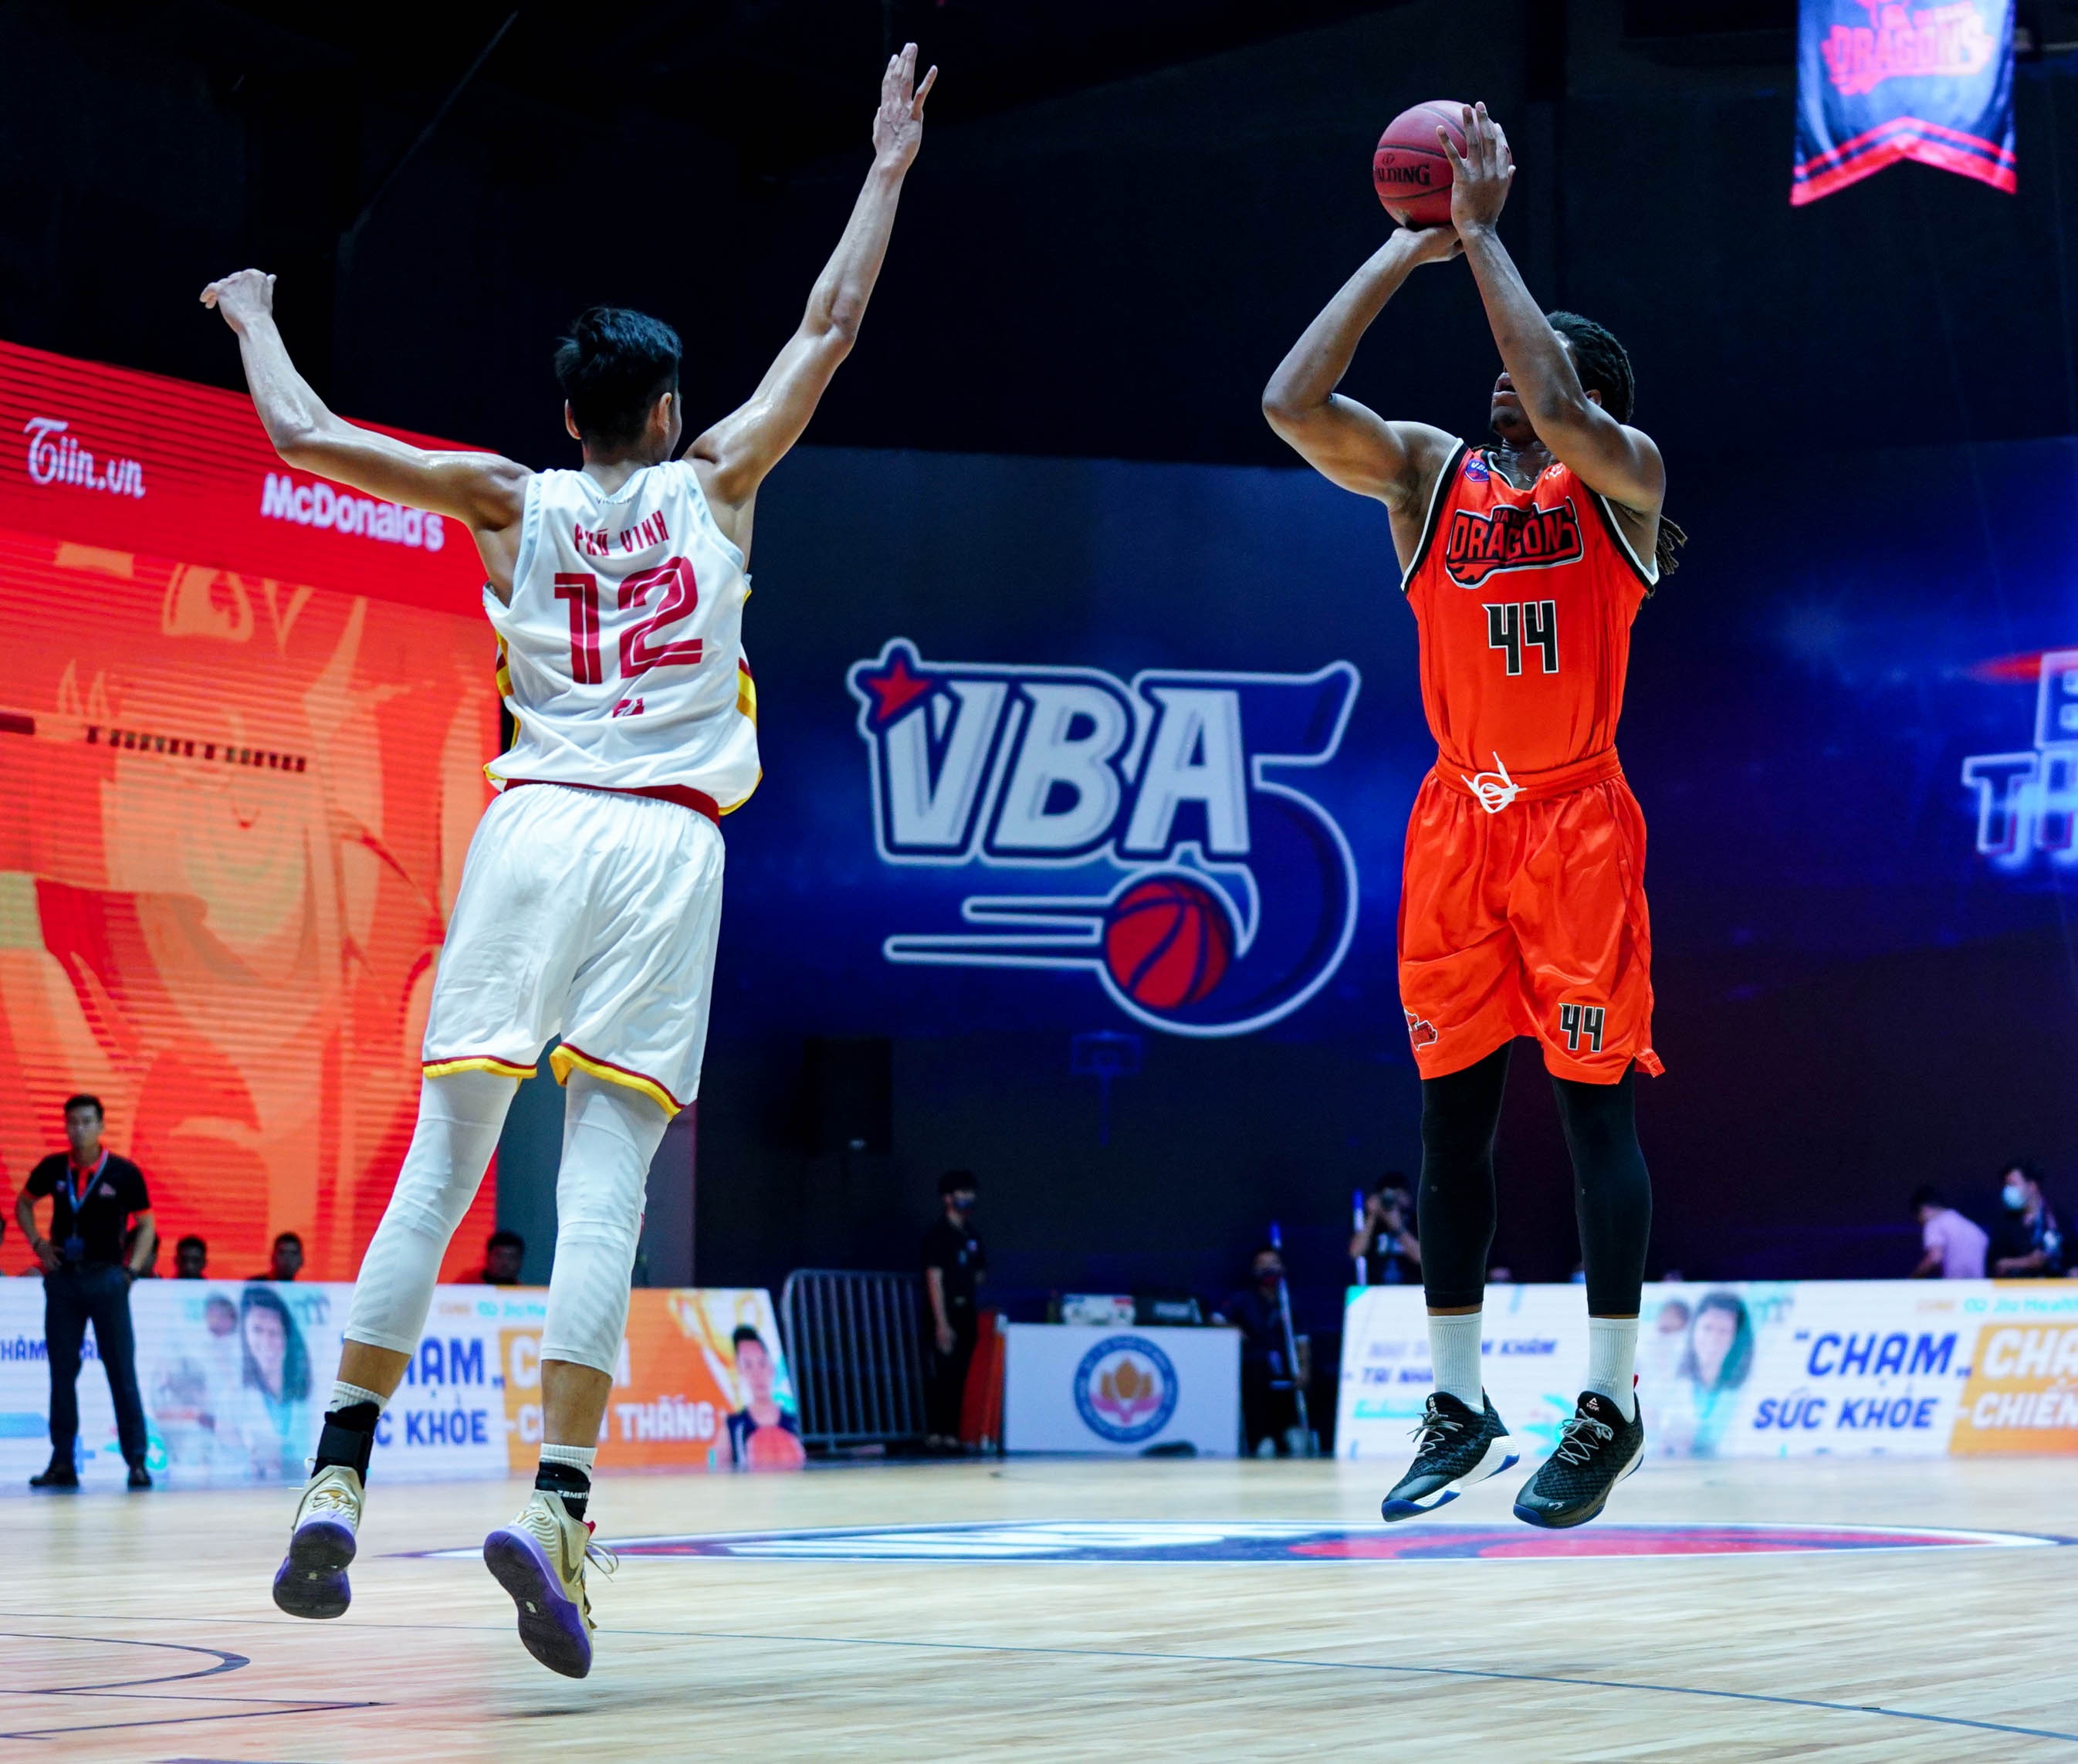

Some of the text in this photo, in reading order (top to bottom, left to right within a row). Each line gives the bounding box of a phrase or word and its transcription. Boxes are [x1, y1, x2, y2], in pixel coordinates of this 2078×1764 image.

[260, 472, 445, 552] McDonalds
[1449, 506, 1581, 561] DRAGONS
[554, 556, 703, 685] 12
[1482, 600, 1559, 676] 44
[885, 679, 1251, 852] VBA
[1558, 1003, 1606, 1053] 44
